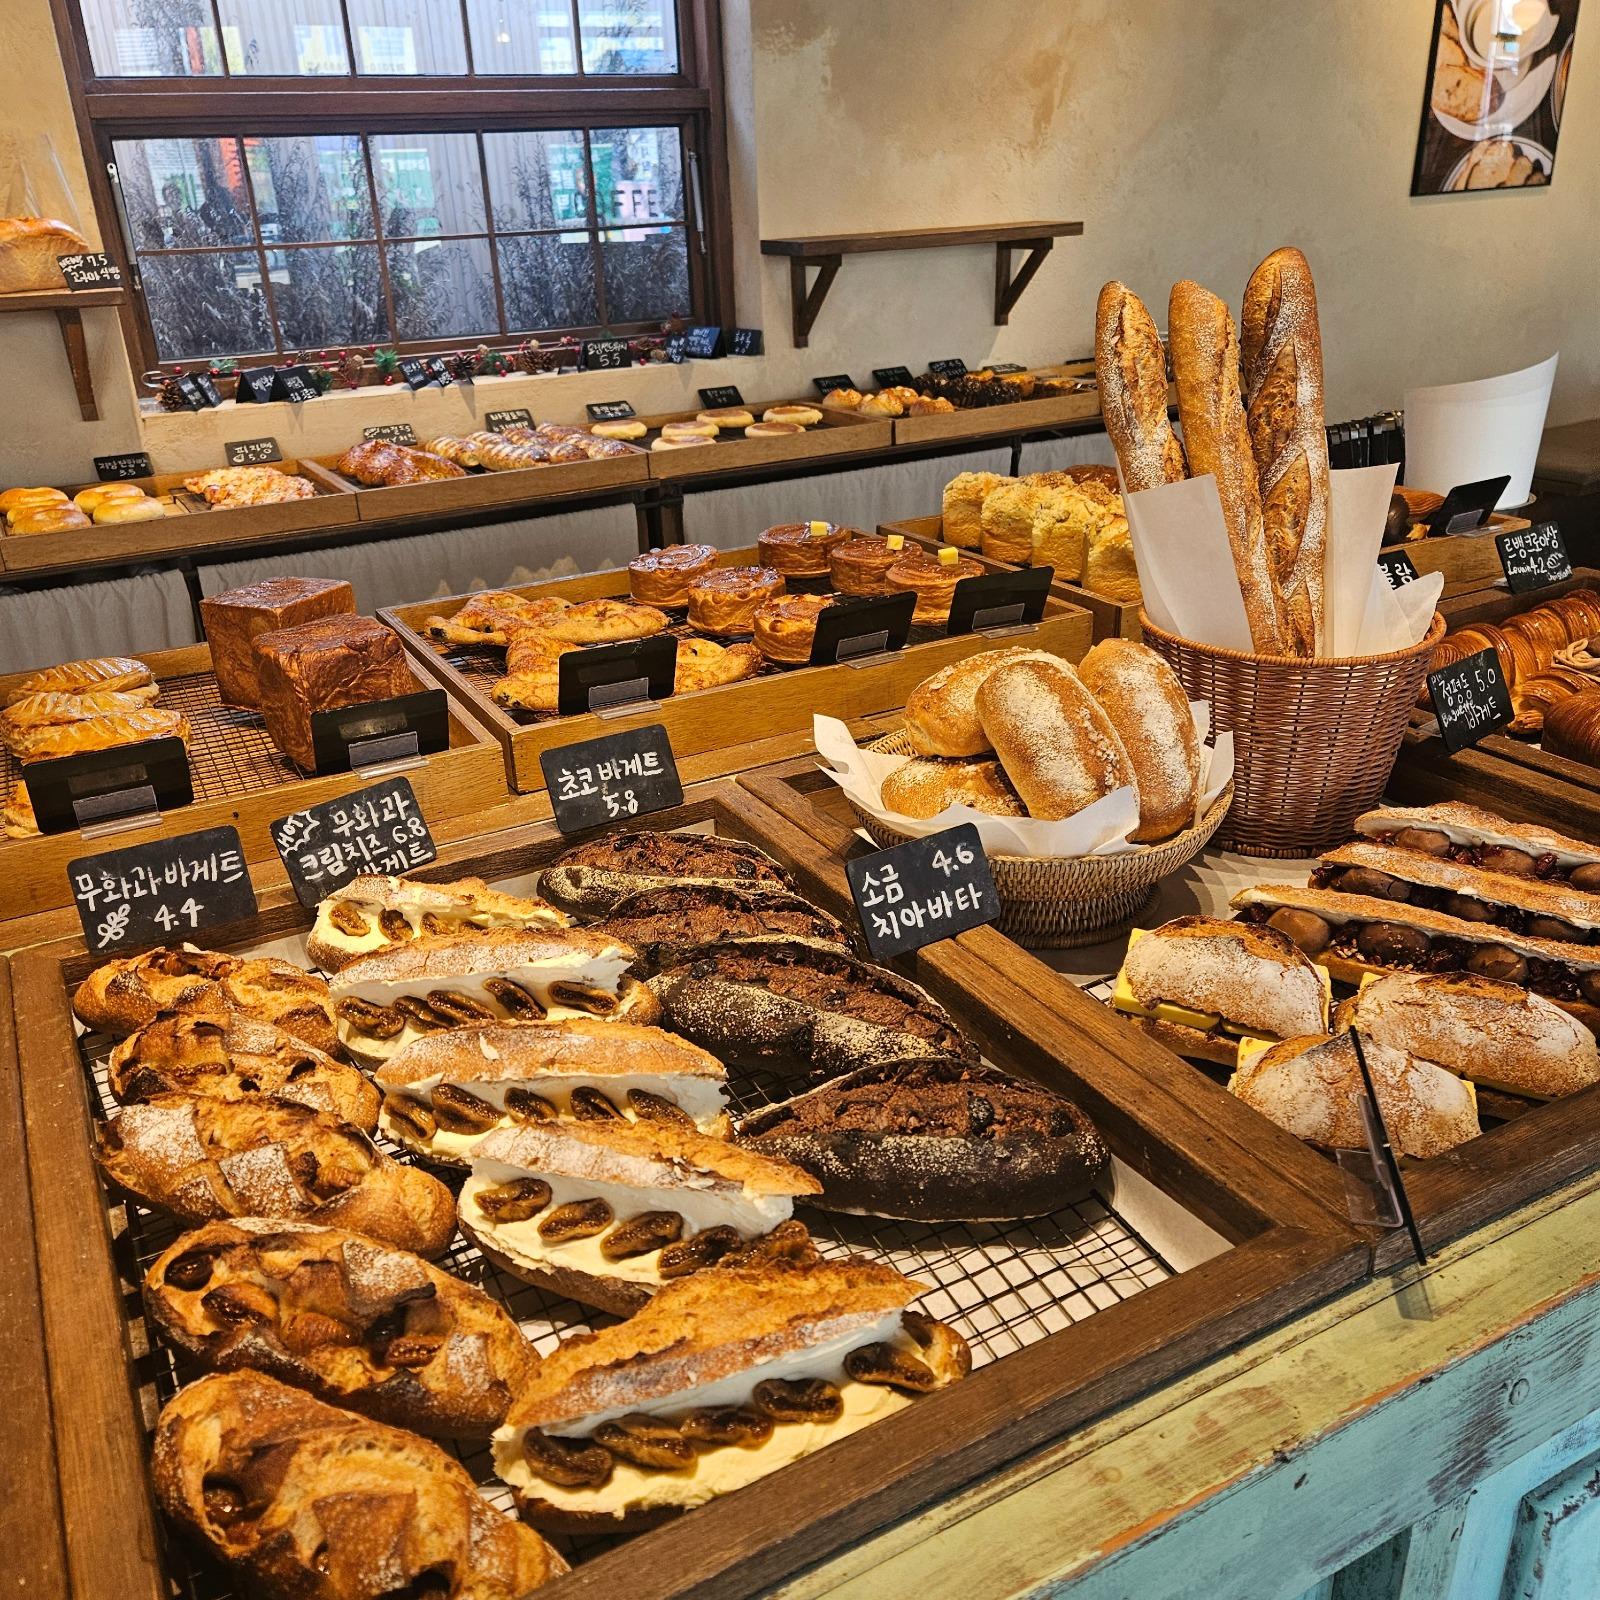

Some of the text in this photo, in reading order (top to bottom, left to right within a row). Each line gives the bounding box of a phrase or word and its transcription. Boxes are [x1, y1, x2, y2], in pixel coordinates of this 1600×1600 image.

[86, 254, 108, 267] 7.5
[1474, 668, 1497, 692] 5.0
[332, 791, 410, 837] 무화과
[601, 789, 639, 818] 5.8
[299, 816, 426, 881] 크림치즈 6.8
[931, 842, 975, 878] 4.6
[861, 863, 905, 908] 소금
[153, 897, 204, 932] 4.4
[870, 882, 983, 940] 치아바타
